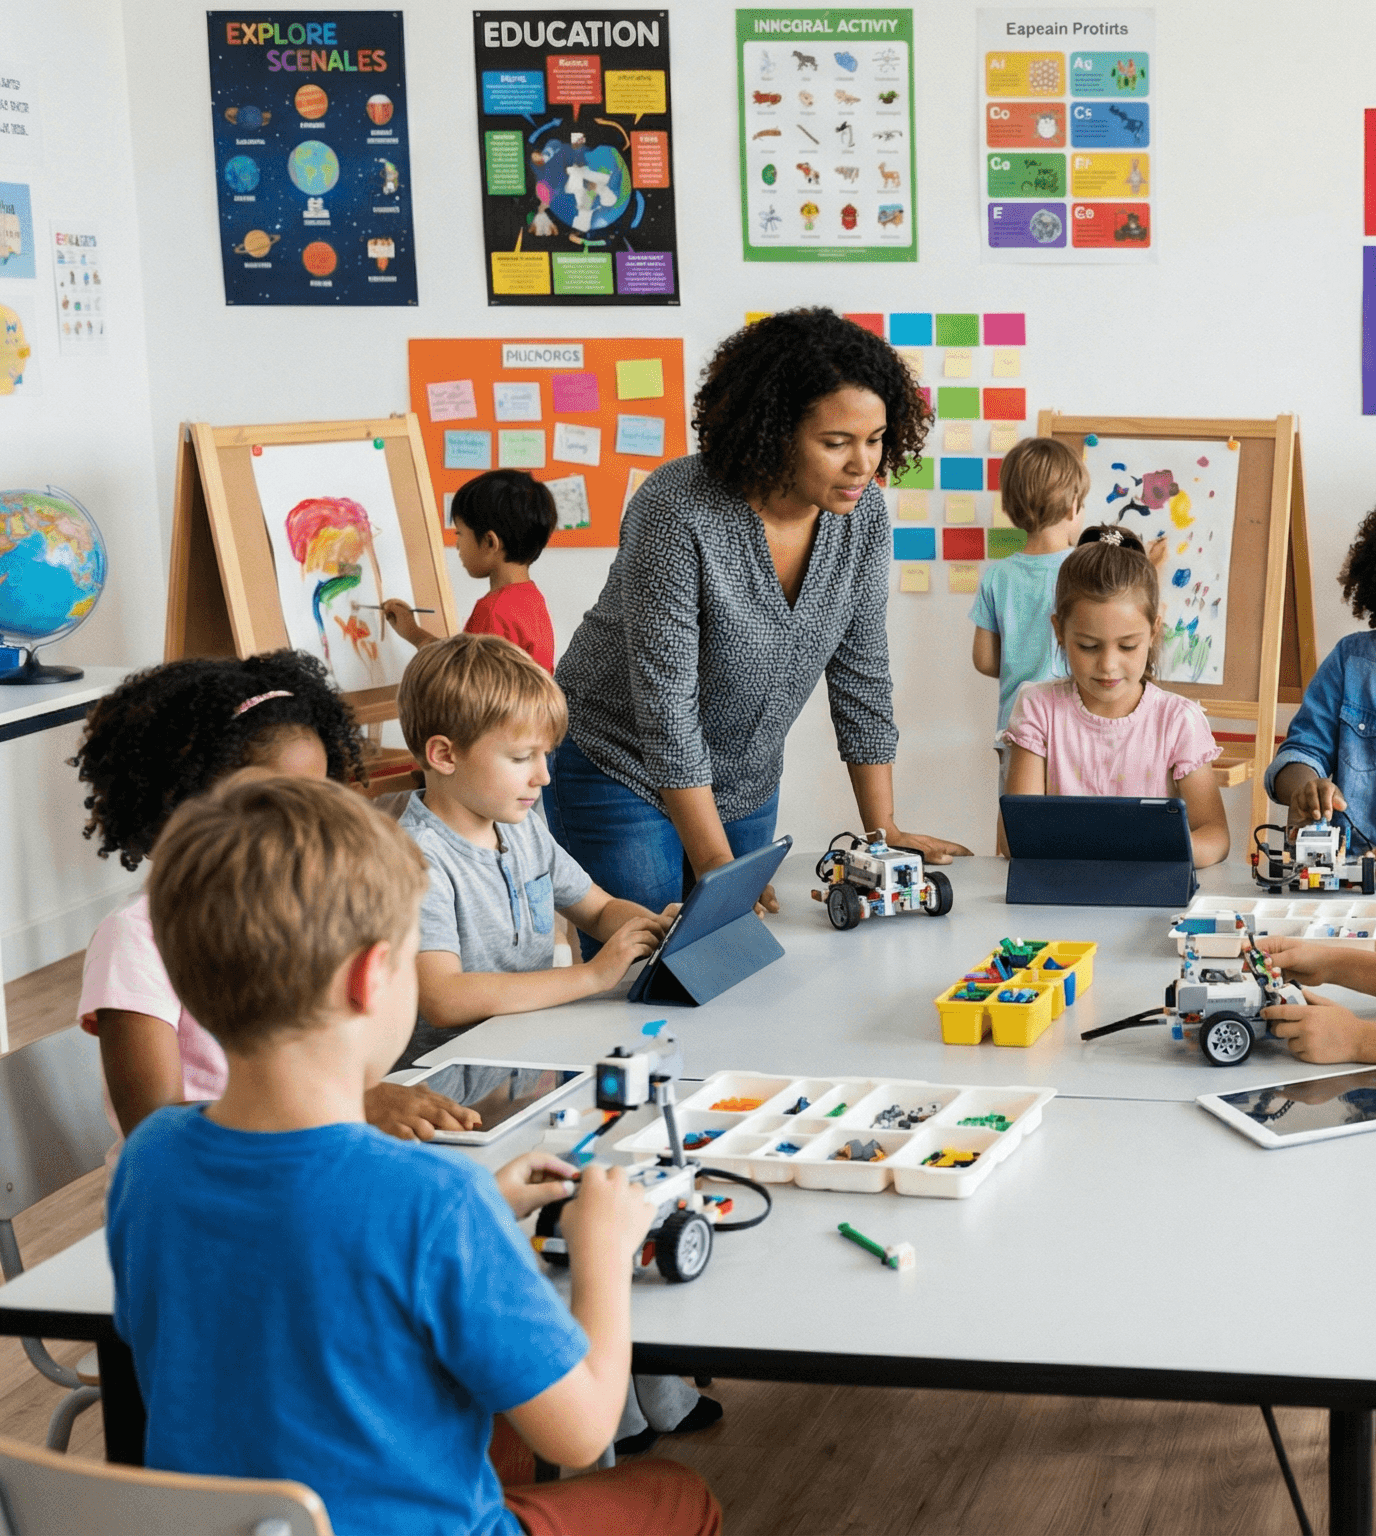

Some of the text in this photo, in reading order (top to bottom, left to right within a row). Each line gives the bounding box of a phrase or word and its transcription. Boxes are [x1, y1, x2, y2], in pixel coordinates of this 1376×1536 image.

[226, 22, 338, 45] EXPLORE
[483, 20, 660, 46] EDUCATION
[266, 49, 388, 72] SCENALES
